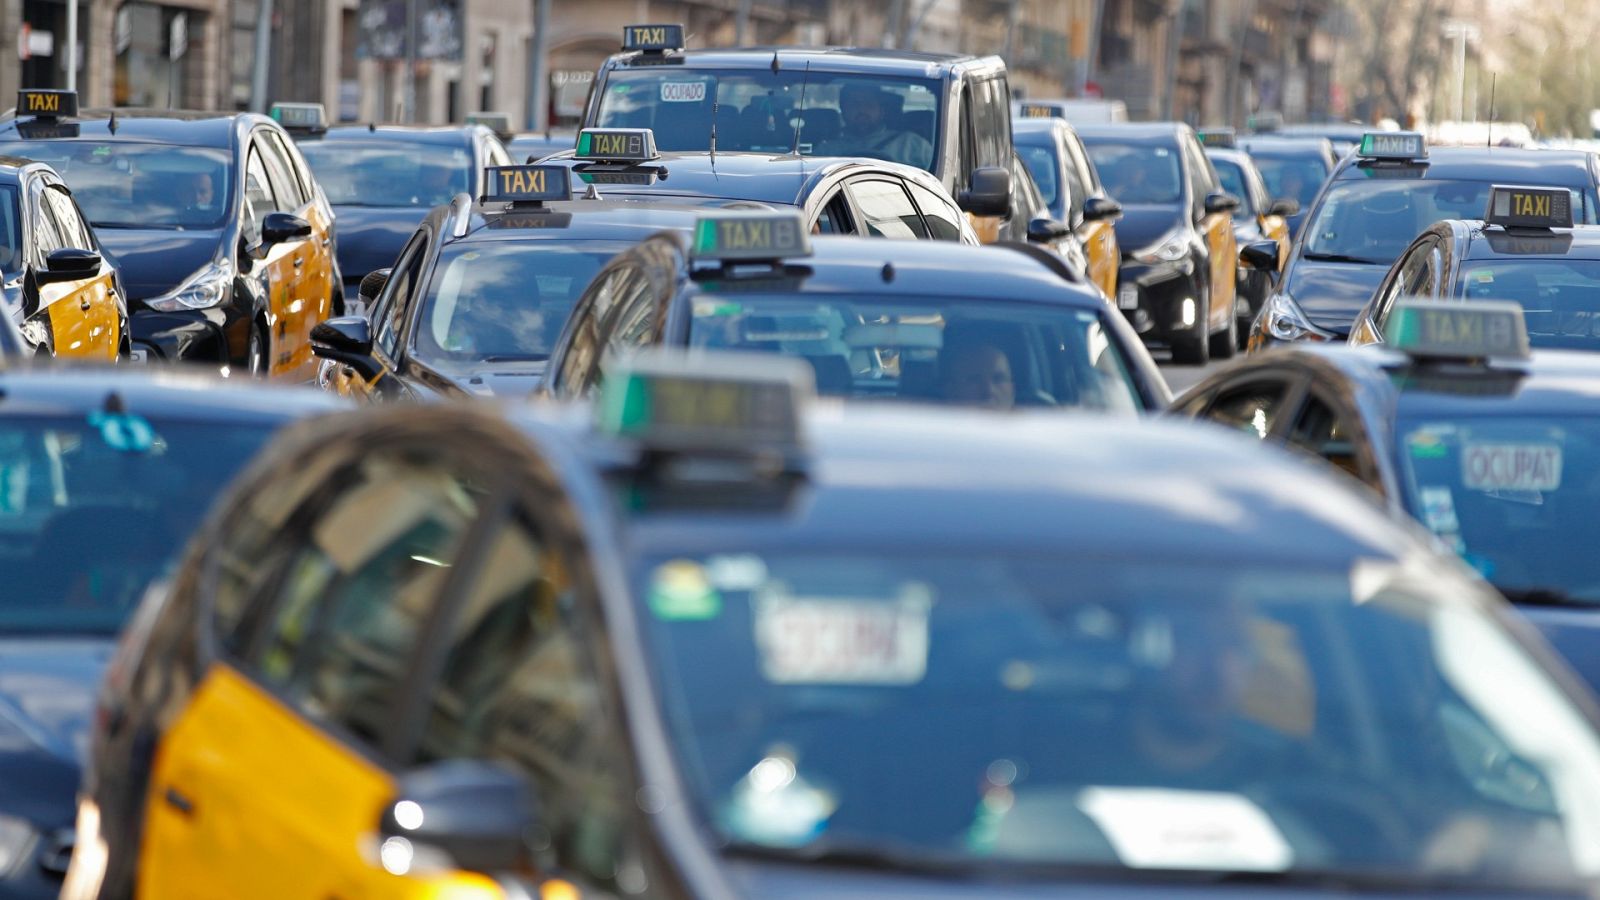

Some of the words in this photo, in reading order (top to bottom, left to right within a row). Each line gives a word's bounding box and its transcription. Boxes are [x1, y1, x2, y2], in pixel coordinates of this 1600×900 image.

[634, 28, 665, 45] TAXI
[663, 84, 703, 100] OCUPADO
[27, 94, 59, 111] TAXI
[594, 135, 626, 154] TAXI
[1375, 136, 1404, 153] TAXI
[500, 170, 545, 193] TAXI
[1513, 194, 1550, 216] TAXI
[722, 222, 770, 249] TAXI
[1425, 311, 1482, 344] TAXI
[1468, 448, 1557, 485] OCUPAT
